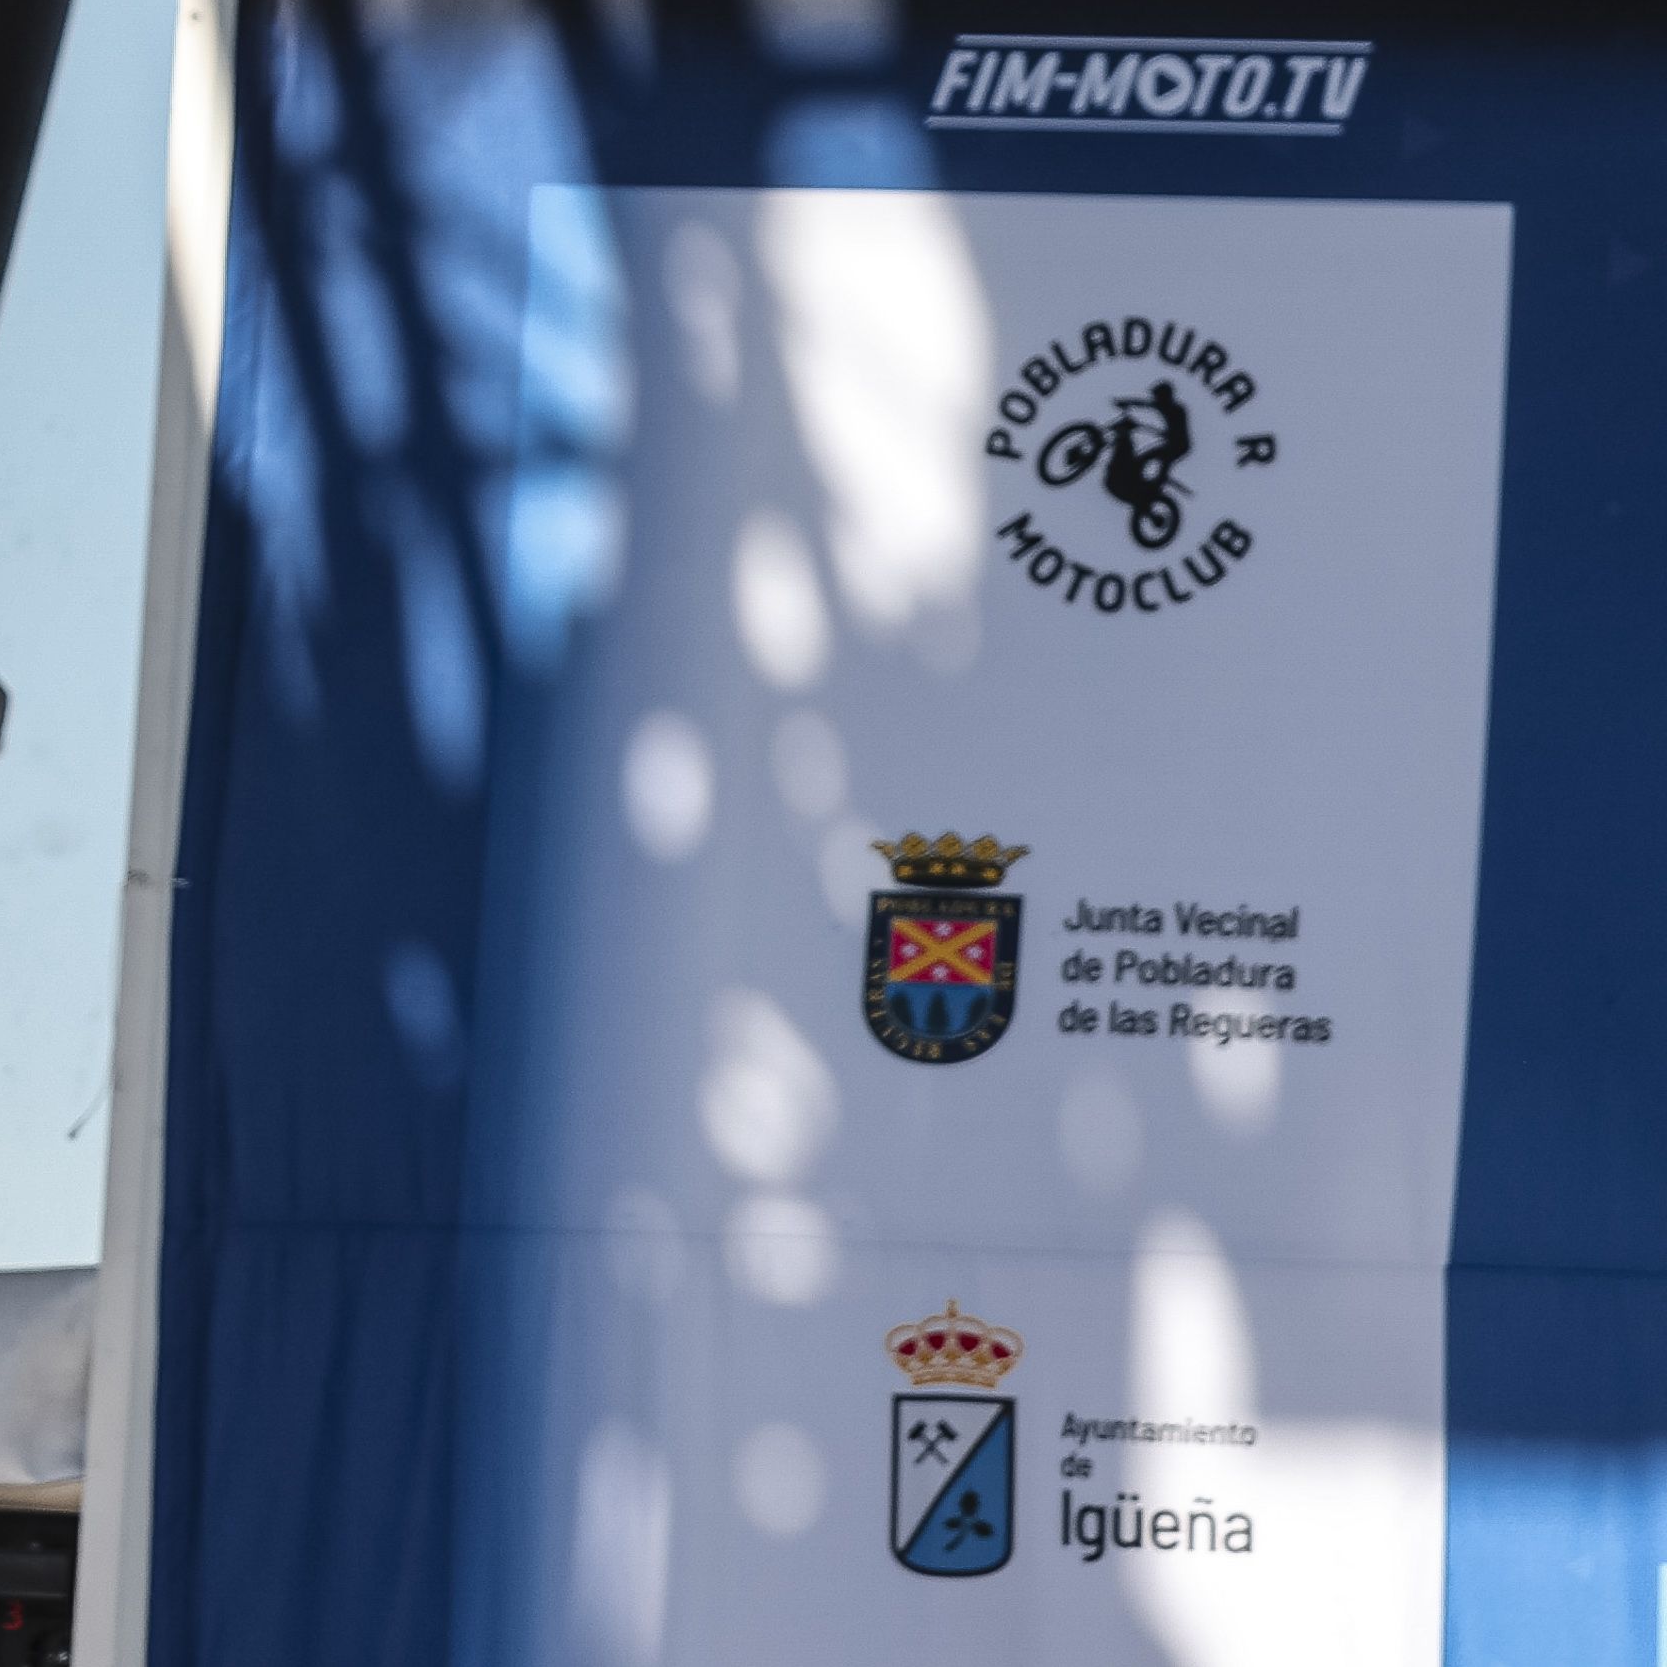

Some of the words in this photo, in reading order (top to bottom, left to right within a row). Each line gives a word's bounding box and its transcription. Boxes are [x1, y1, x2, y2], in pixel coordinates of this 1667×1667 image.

[930, 50, 1369, 118] FIM-MOTO.TV
[986, 316, 1257, 461] POBLADURA
[1236, 434, 1277, 468] R
[997, 513, 1253, 614] MOTOCLUB
[1064, 898, 1163, 935] Junta
[1173, 902, 1300, 939] Vecinal
[1062, 951, 1104, 984] de
[1114, 950, 1296, 992] Pobladura
[1058, 1002, 1100, 1035] de
[1109, 1003, 1158, 1037] las
[1168, 1004, 1333, 1046] Regueras
[1060, 1411, 1258, 1447] Ayuntamiento
[1061, 1450, 1092, 1479] de
[1061, 1489, 1254, 1562] Igüeña
